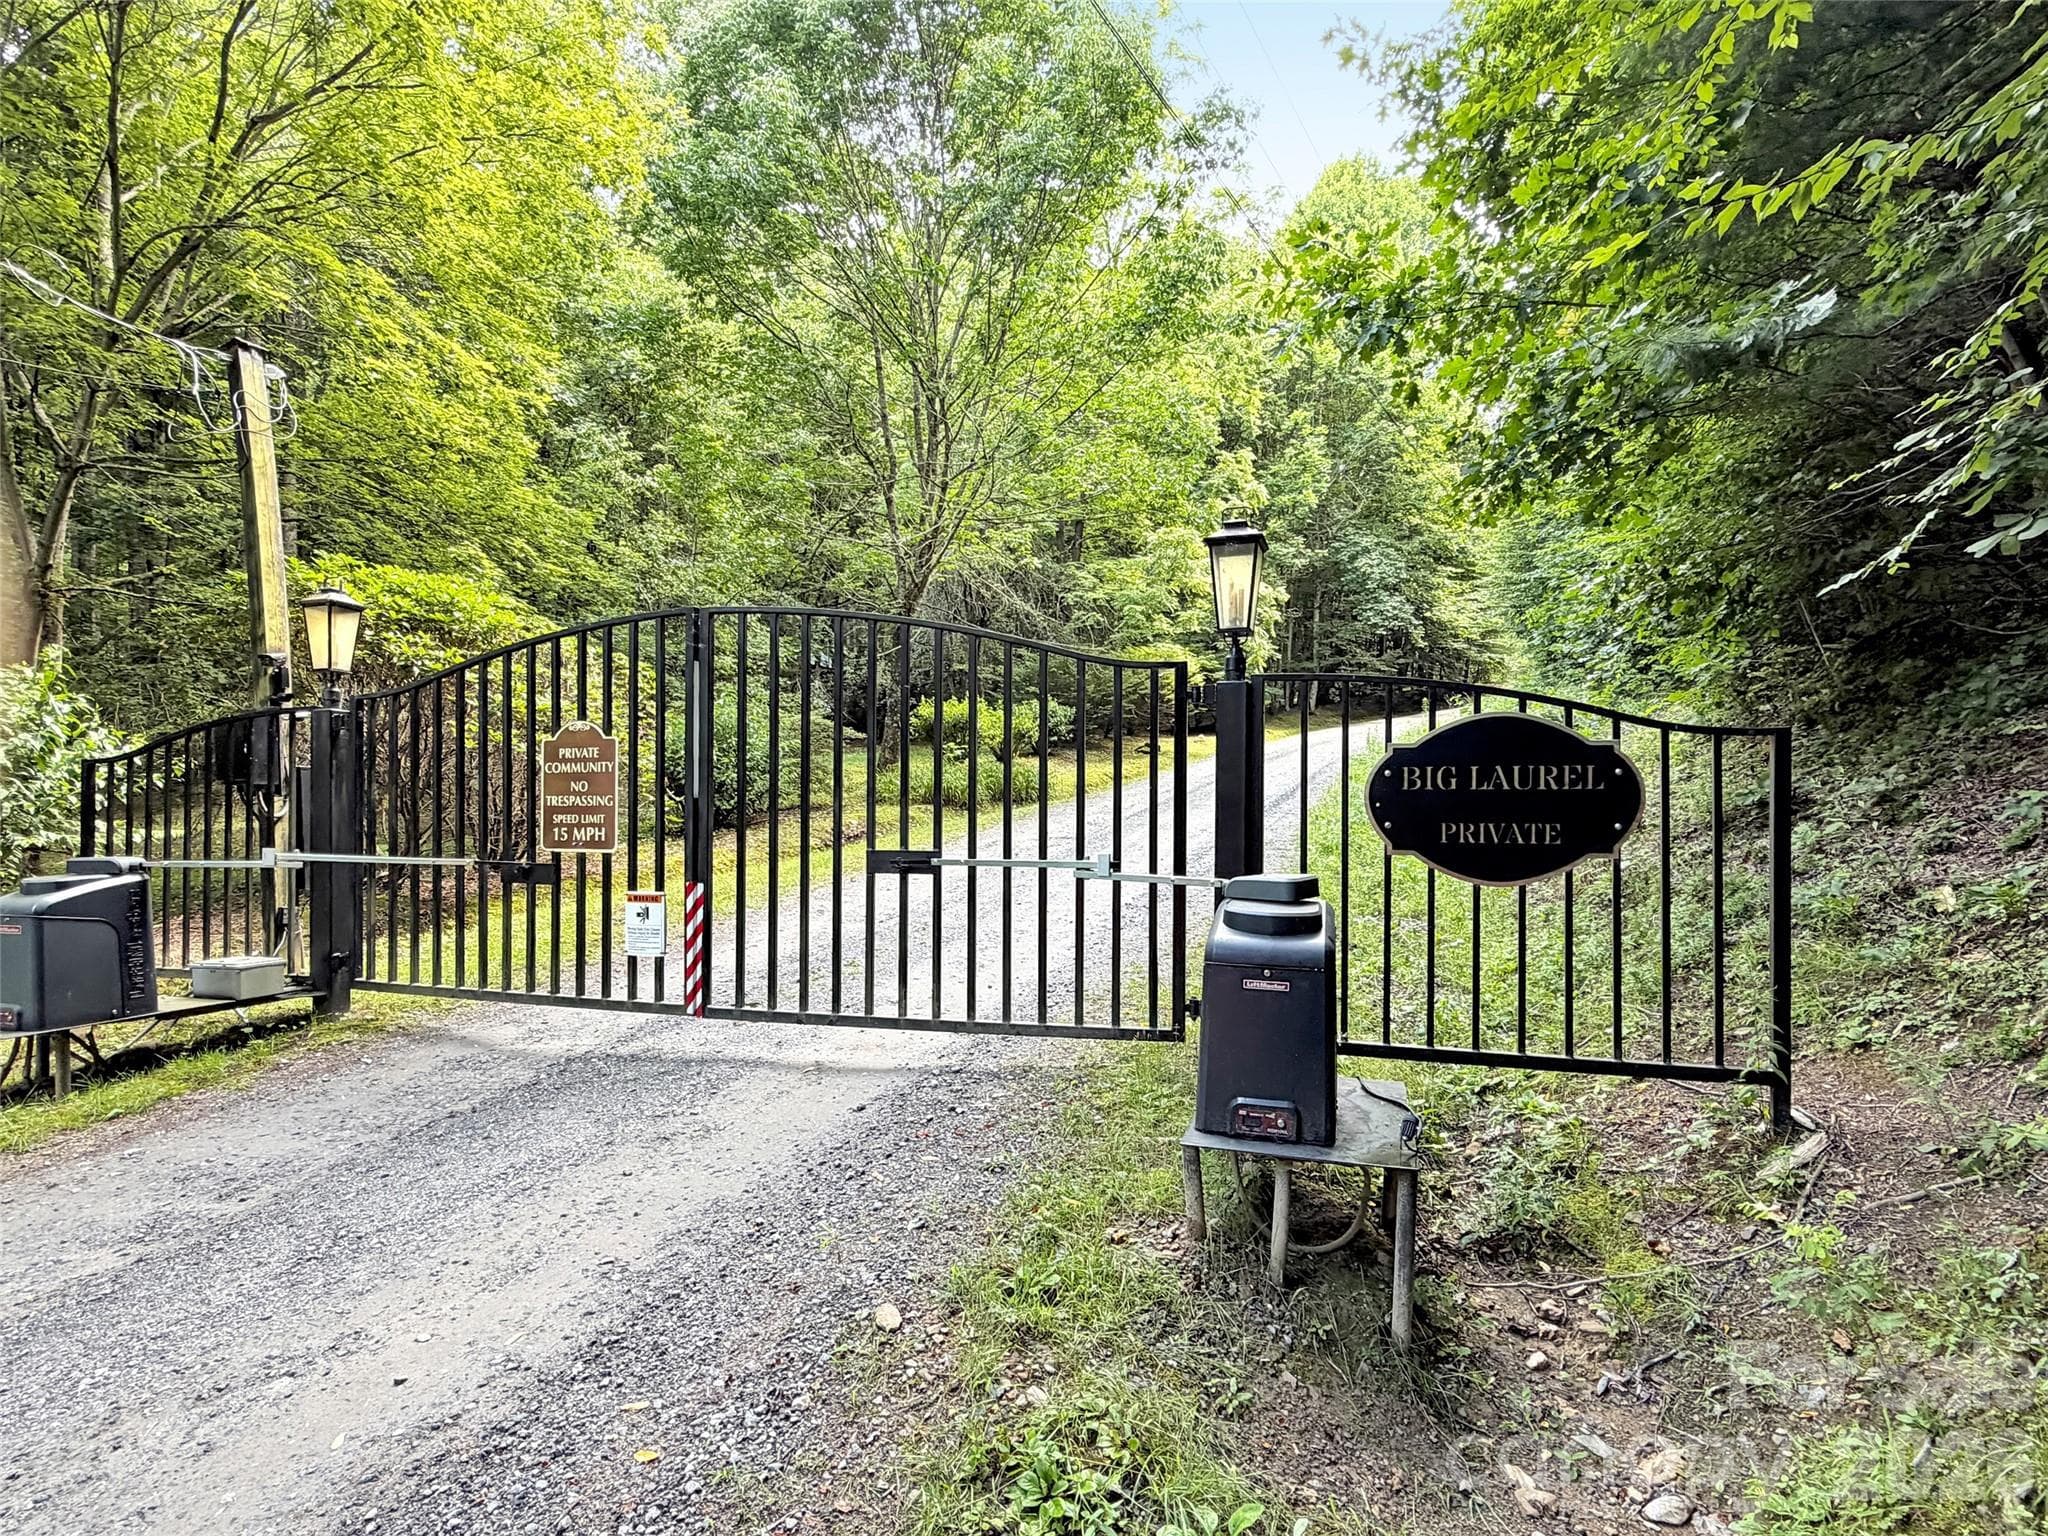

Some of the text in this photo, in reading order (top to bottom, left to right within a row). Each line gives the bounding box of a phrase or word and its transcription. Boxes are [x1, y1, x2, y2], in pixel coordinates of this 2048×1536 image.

[559, 747, 600, 759] PRIVATE
[544, 761, 614, 774] COMMUNITY
[1402, 765, 1605, 791] BIG LAUREL
[570, 780, 589, 792] NO
[545, 795, 614, 807] TRESPASSING
[552, 814, 606, 824] SPEED LIMIT
[553, 827, 606, 841] 15 MPH
[1440, 822, 1562, 845] PRIVATE
